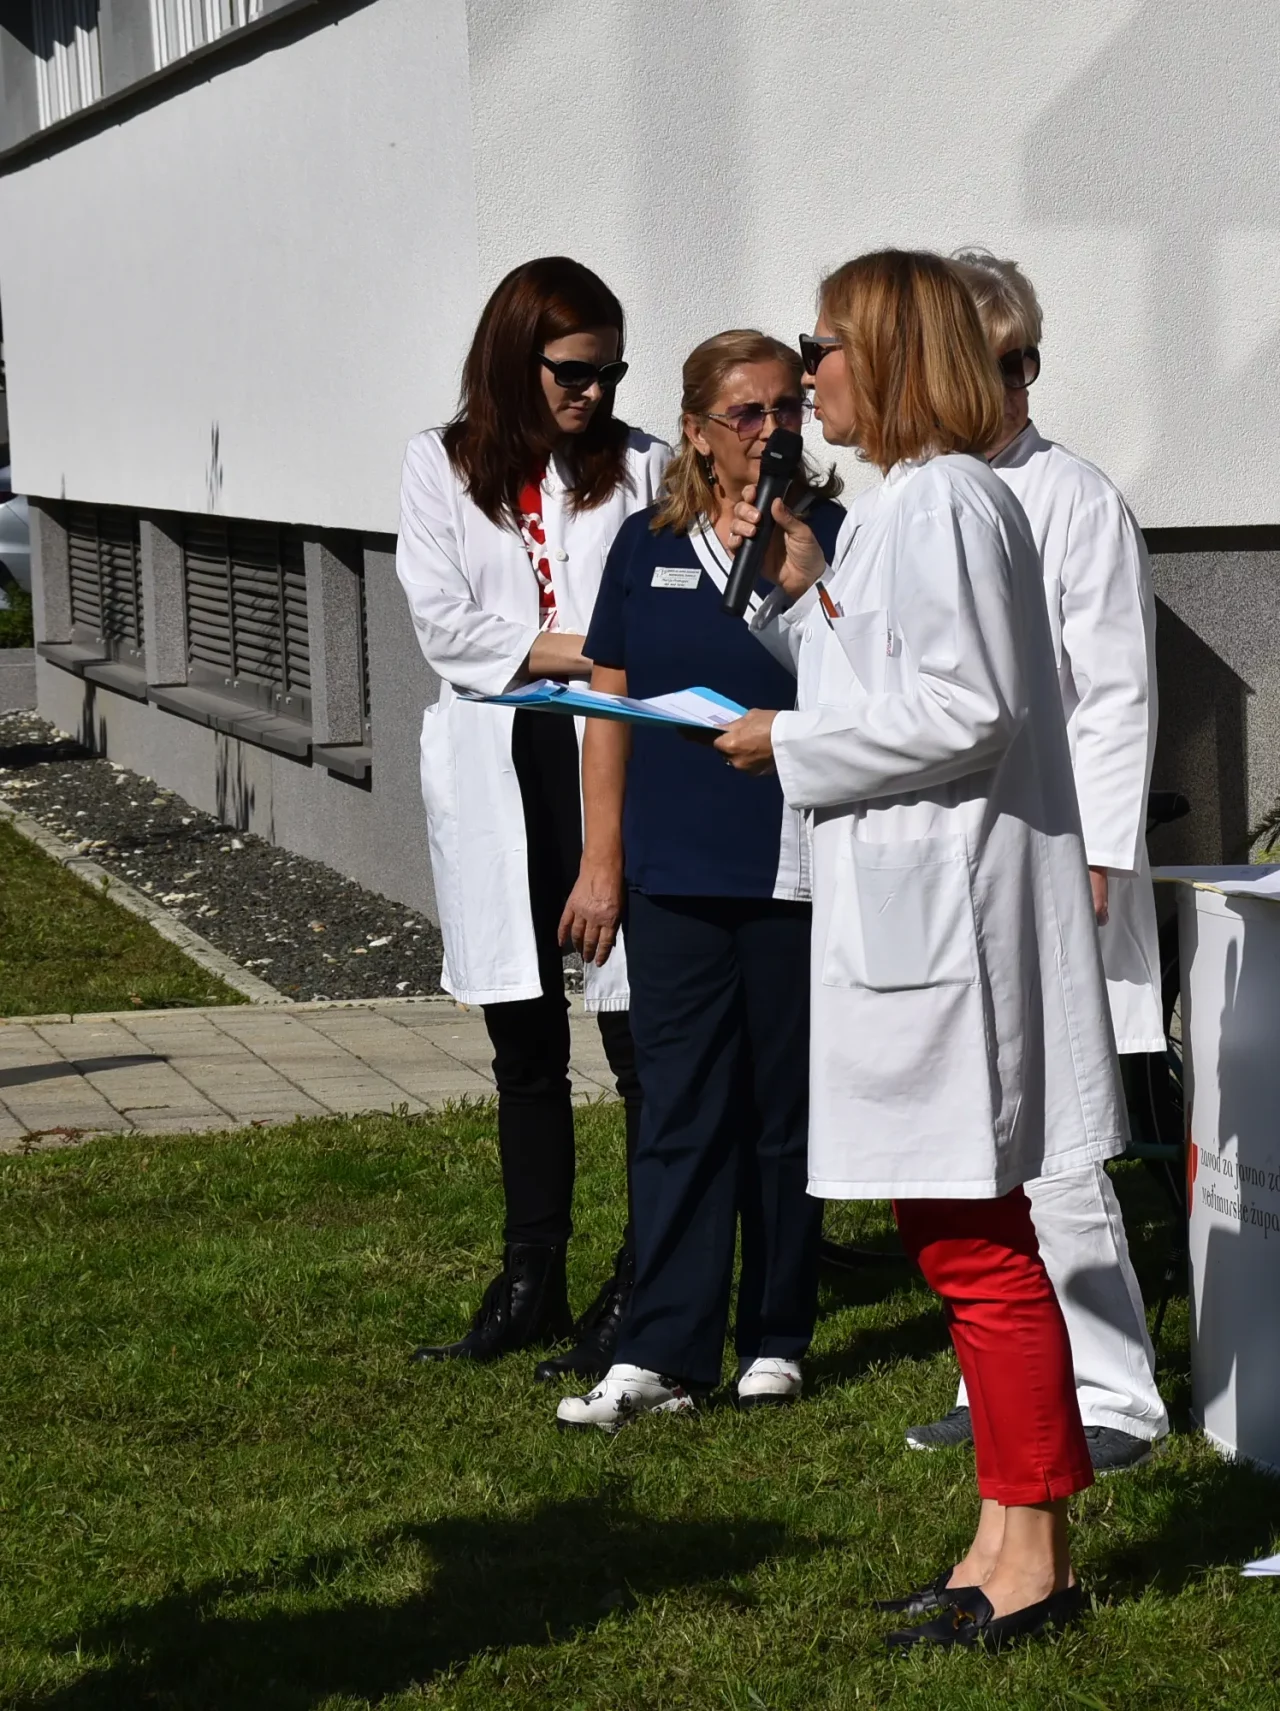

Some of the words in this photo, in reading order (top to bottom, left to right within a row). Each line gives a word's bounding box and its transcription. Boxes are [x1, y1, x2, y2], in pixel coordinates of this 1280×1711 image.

[1200, 1147, 1221, 1173] zavod
[1222, 1158, 1234, 1178] za
[1234, 1152, 1265, 1190] javno
